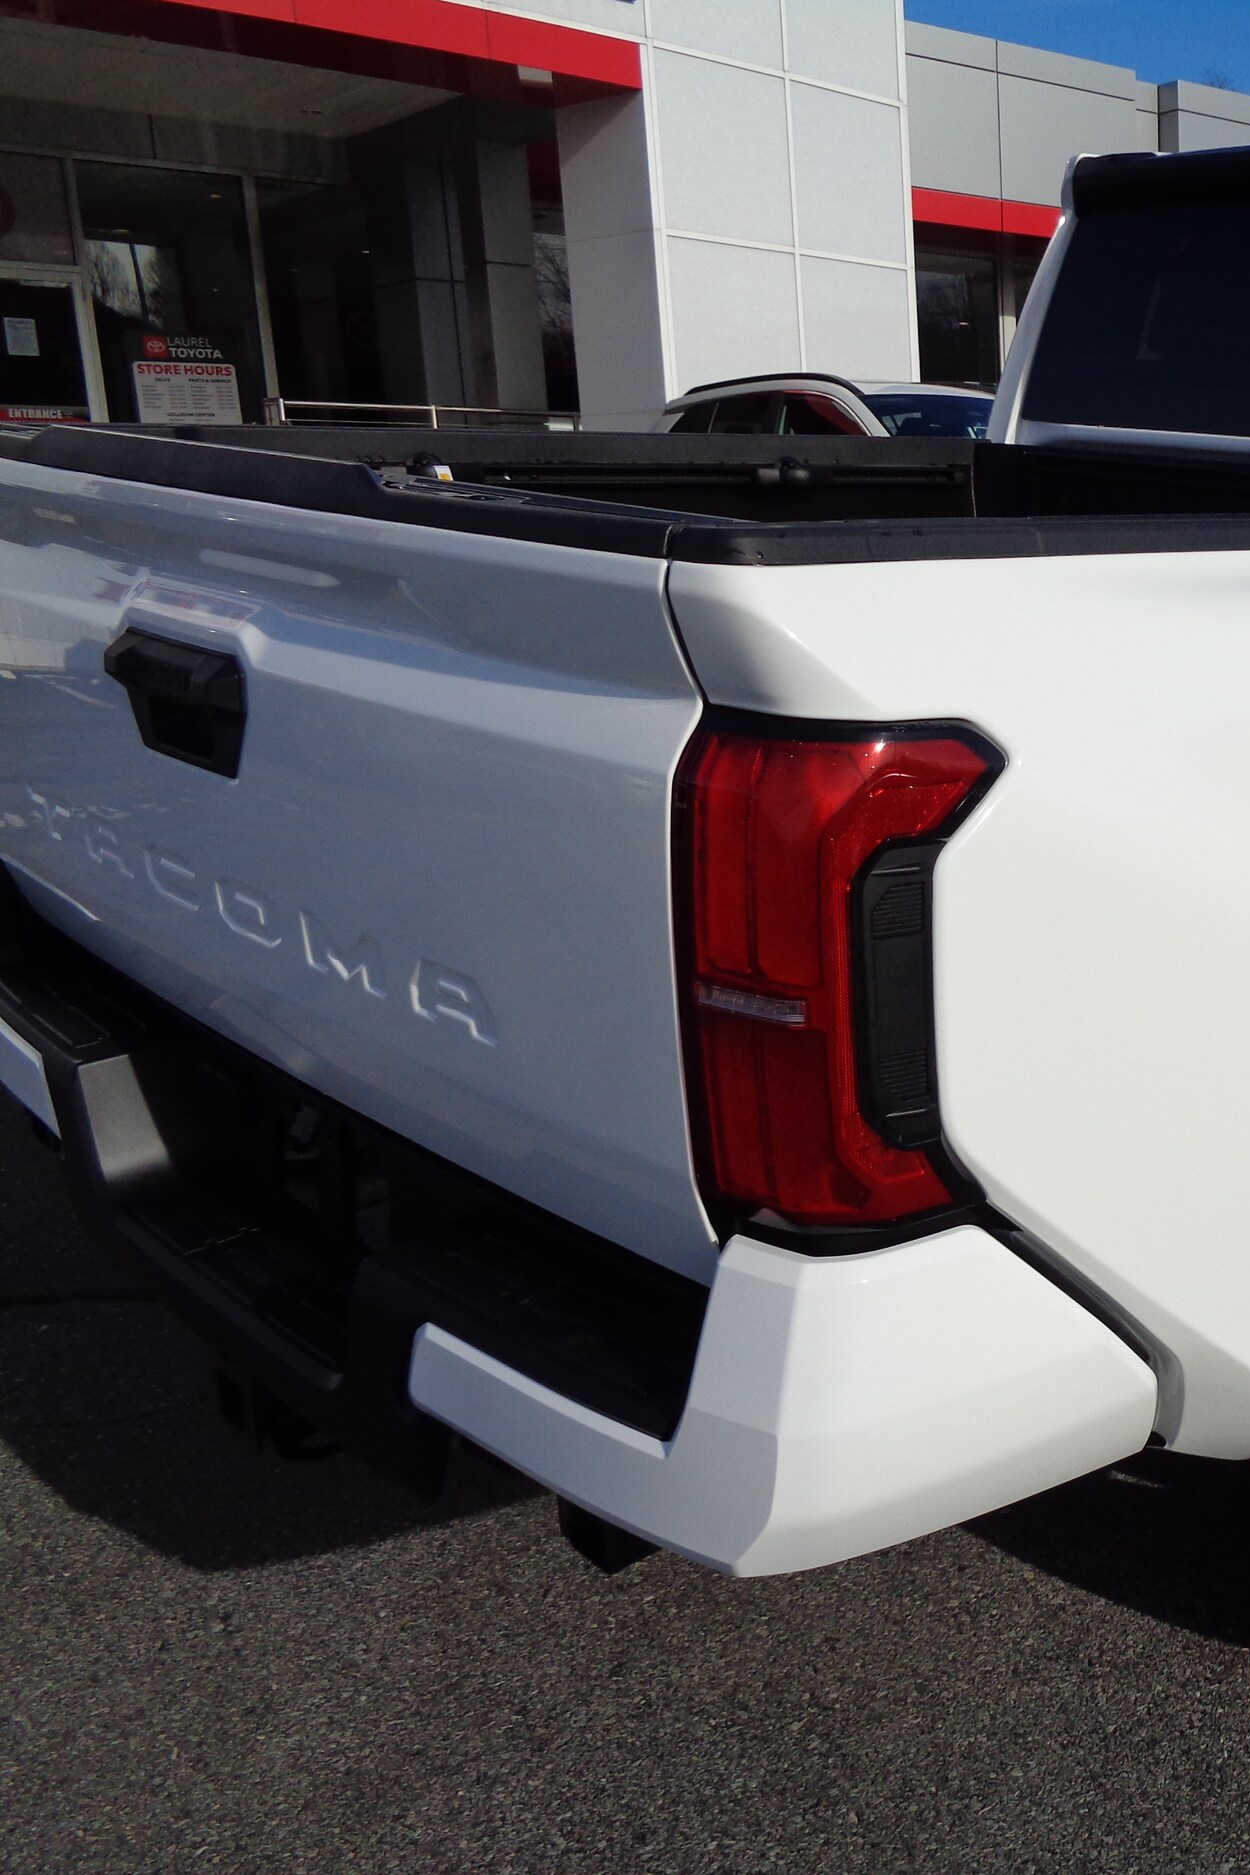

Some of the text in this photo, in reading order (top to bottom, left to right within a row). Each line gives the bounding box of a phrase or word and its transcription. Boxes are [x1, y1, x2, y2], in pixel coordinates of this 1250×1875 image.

[166, 336, 213, 348] LAUREL
[168, 347, 223, 359] TOYOTA
[137, 363, 232, 377] STORE HOURS
[8, 408, 63, 419] ENTRANCE
[25, 783, 498, 1047] TACOMA
